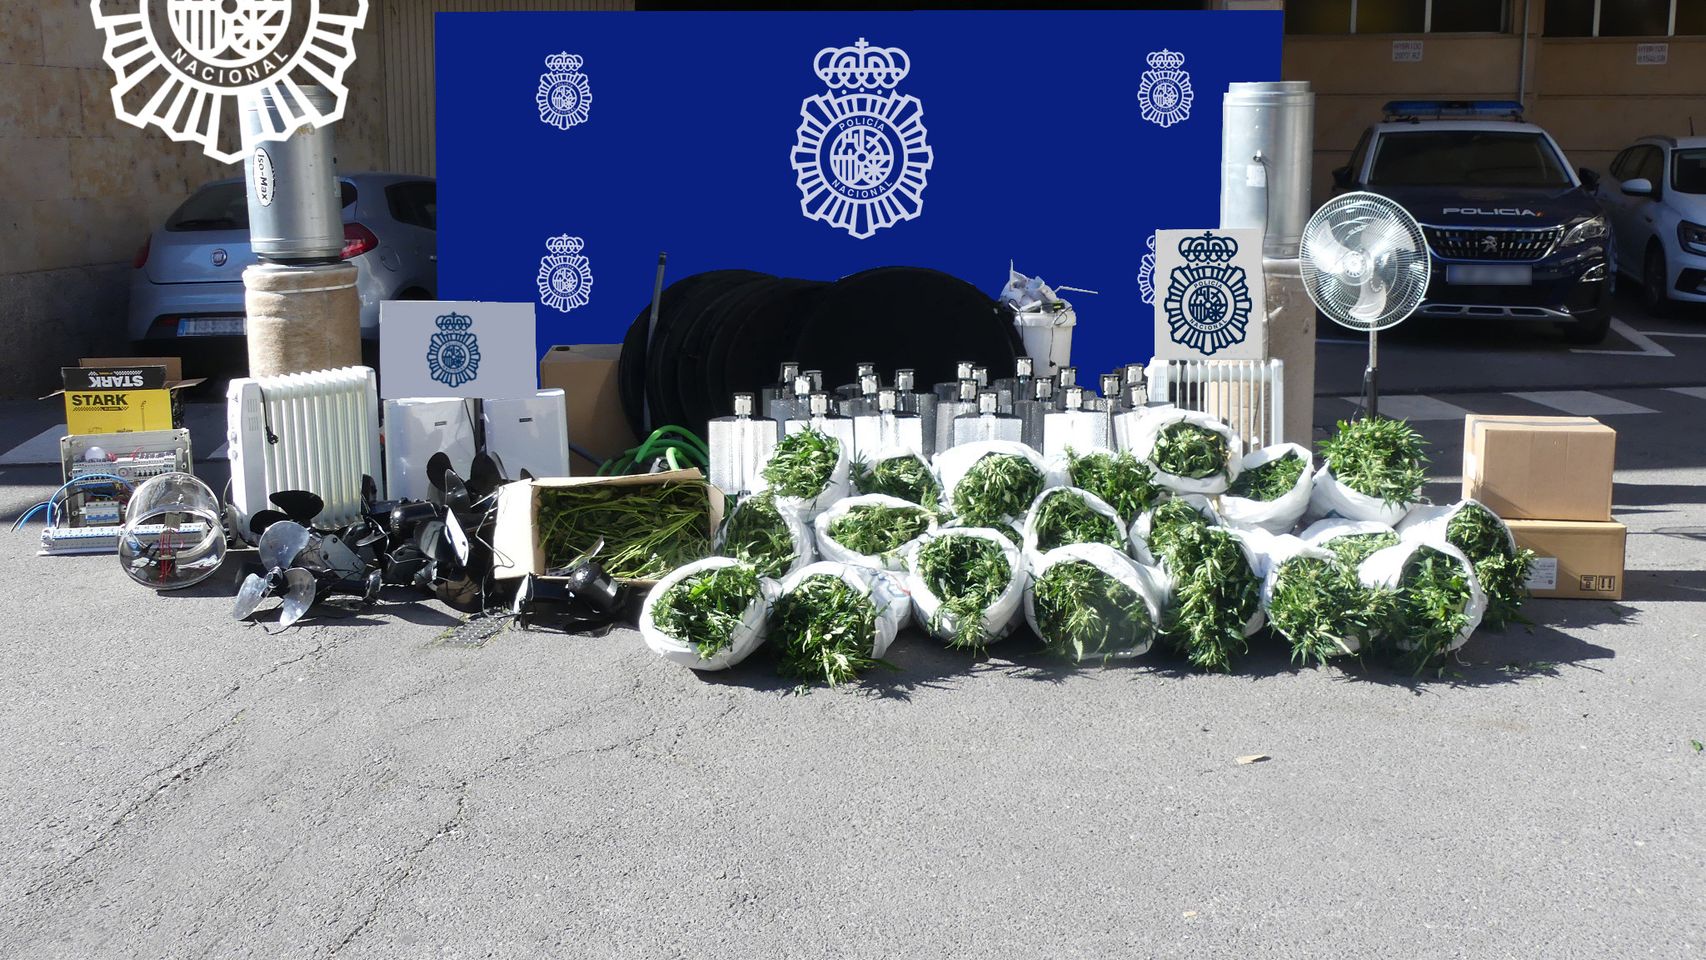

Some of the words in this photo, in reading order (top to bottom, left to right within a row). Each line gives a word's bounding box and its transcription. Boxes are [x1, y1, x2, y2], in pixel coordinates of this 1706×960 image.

[838, 117, 885, 132] POLICÍA
[257, 153, 269, 201] Iso-Max
[831, 178, 893, 200] NACIONAL
[1188, 318, 1229, 331] NACIONAL
[88, 374, 144, 388] STARK
[72, 393, 129, 406] STARK
